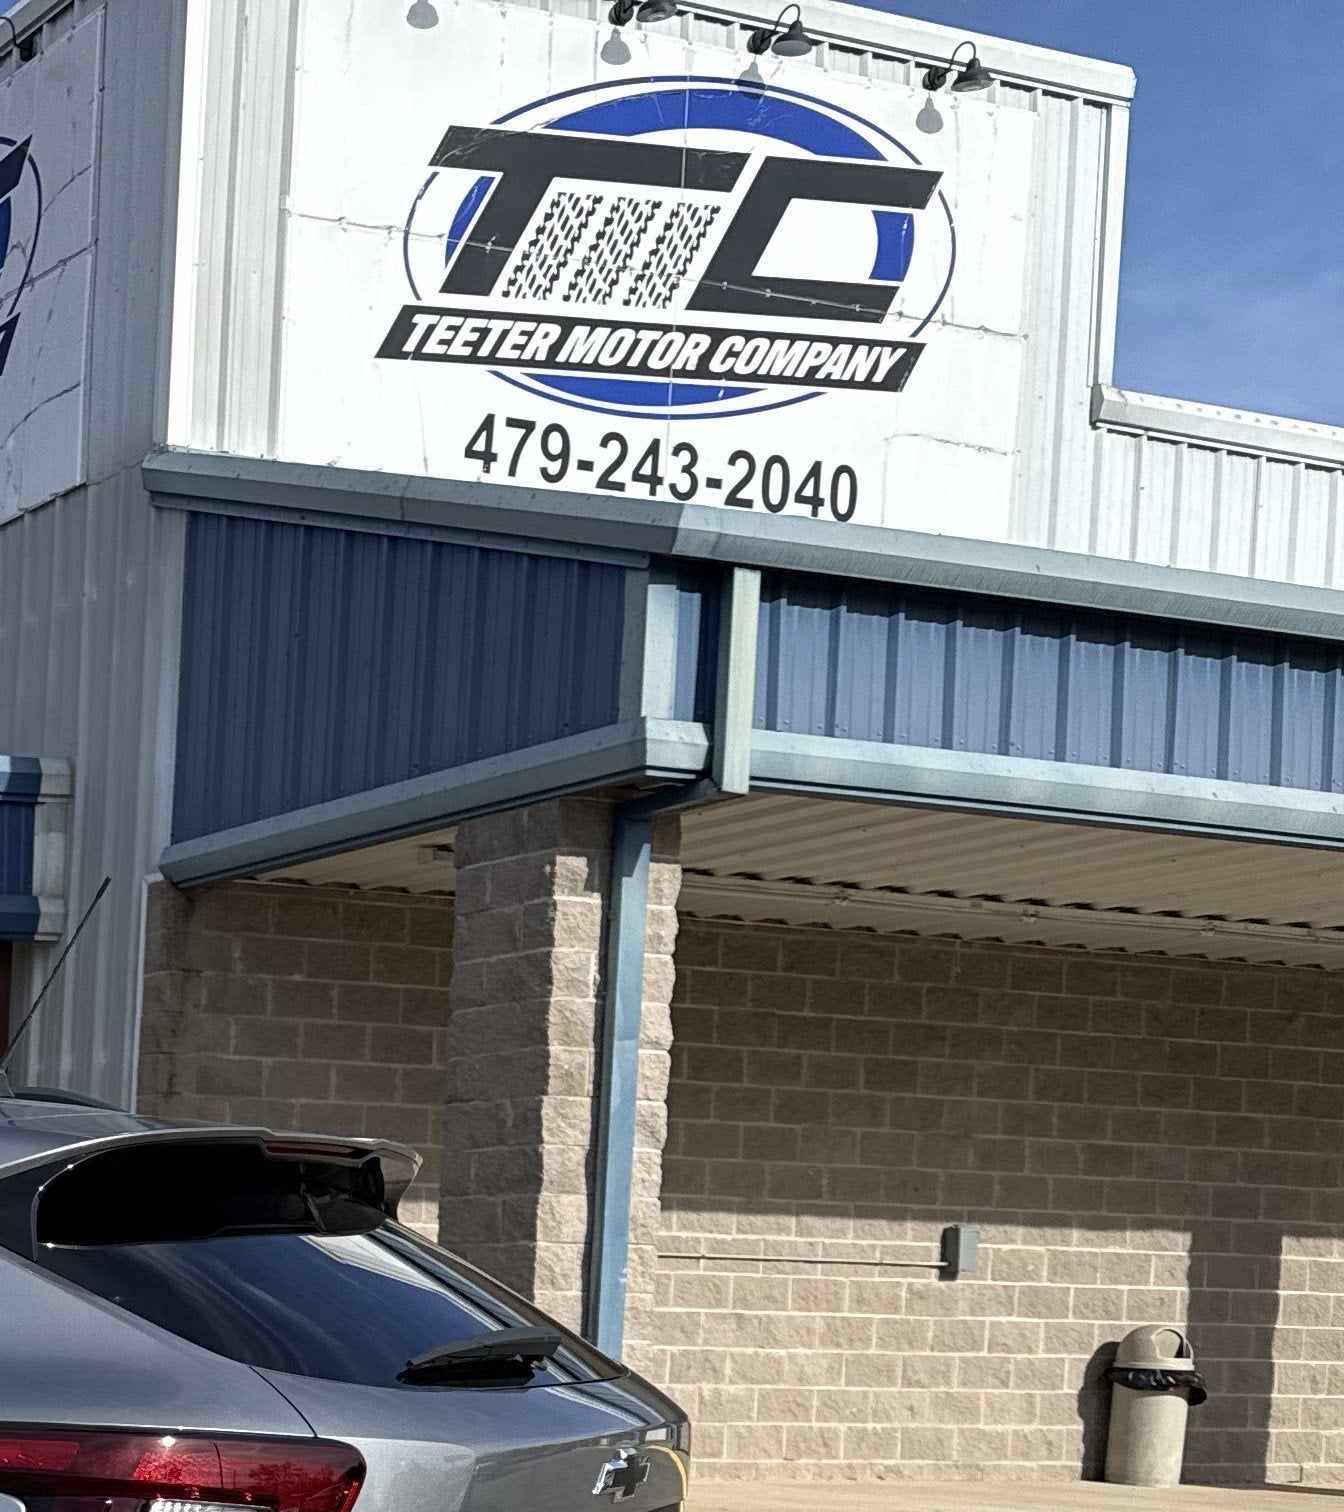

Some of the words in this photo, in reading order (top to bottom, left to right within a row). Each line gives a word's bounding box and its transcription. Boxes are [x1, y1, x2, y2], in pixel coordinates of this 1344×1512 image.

[401, 313, 562, 361] TEETER
[555, 325, 712, 371] MOTOR
[708, 335, 907, 382] COMPANY
[464, 413, 858, 522] 479-243-2040
